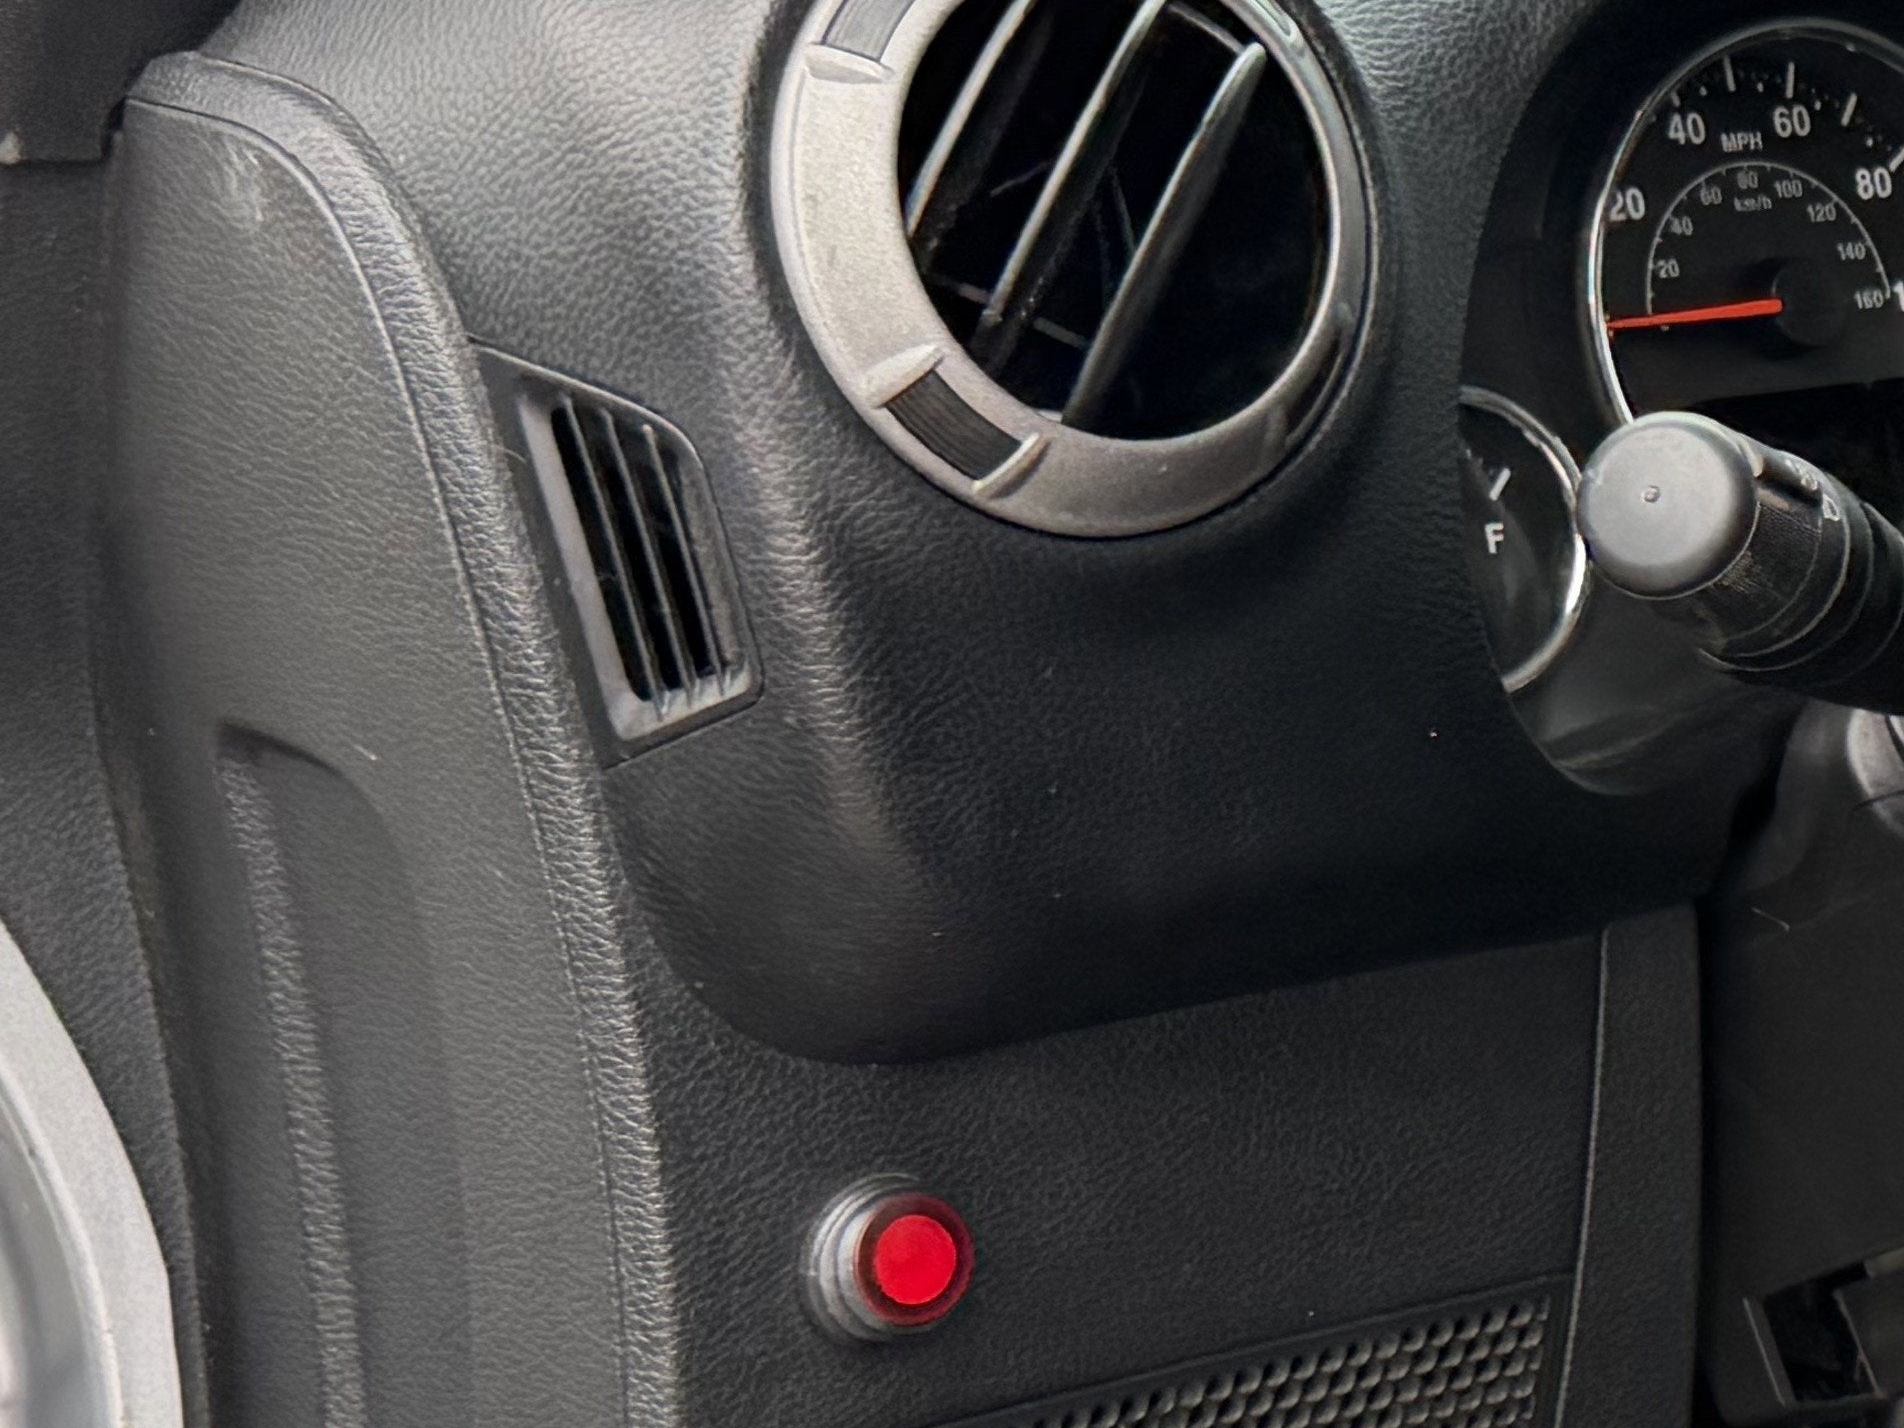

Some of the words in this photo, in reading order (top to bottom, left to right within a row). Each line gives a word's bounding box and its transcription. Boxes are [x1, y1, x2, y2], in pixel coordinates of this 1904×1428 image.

[1667, 112, 1706, 145] 40
[1773, 105, 1811, 138] 60
[1720, 132, 1763, 152] MPH
[1774, 178, 1803, 199] 100
[1855, 167, 1892, 200] 80
[1609, 187, 1645, 222] 20
[1806, 203, 1837, 222] 120
[1670, 215, 1693, 236] 40
[1836, 241, 1866, 261] 140
[1657, 259, 1680, 279] 20
[1854, 289, 1884, 309] 160
[1485, 523, 1504, 554] F
